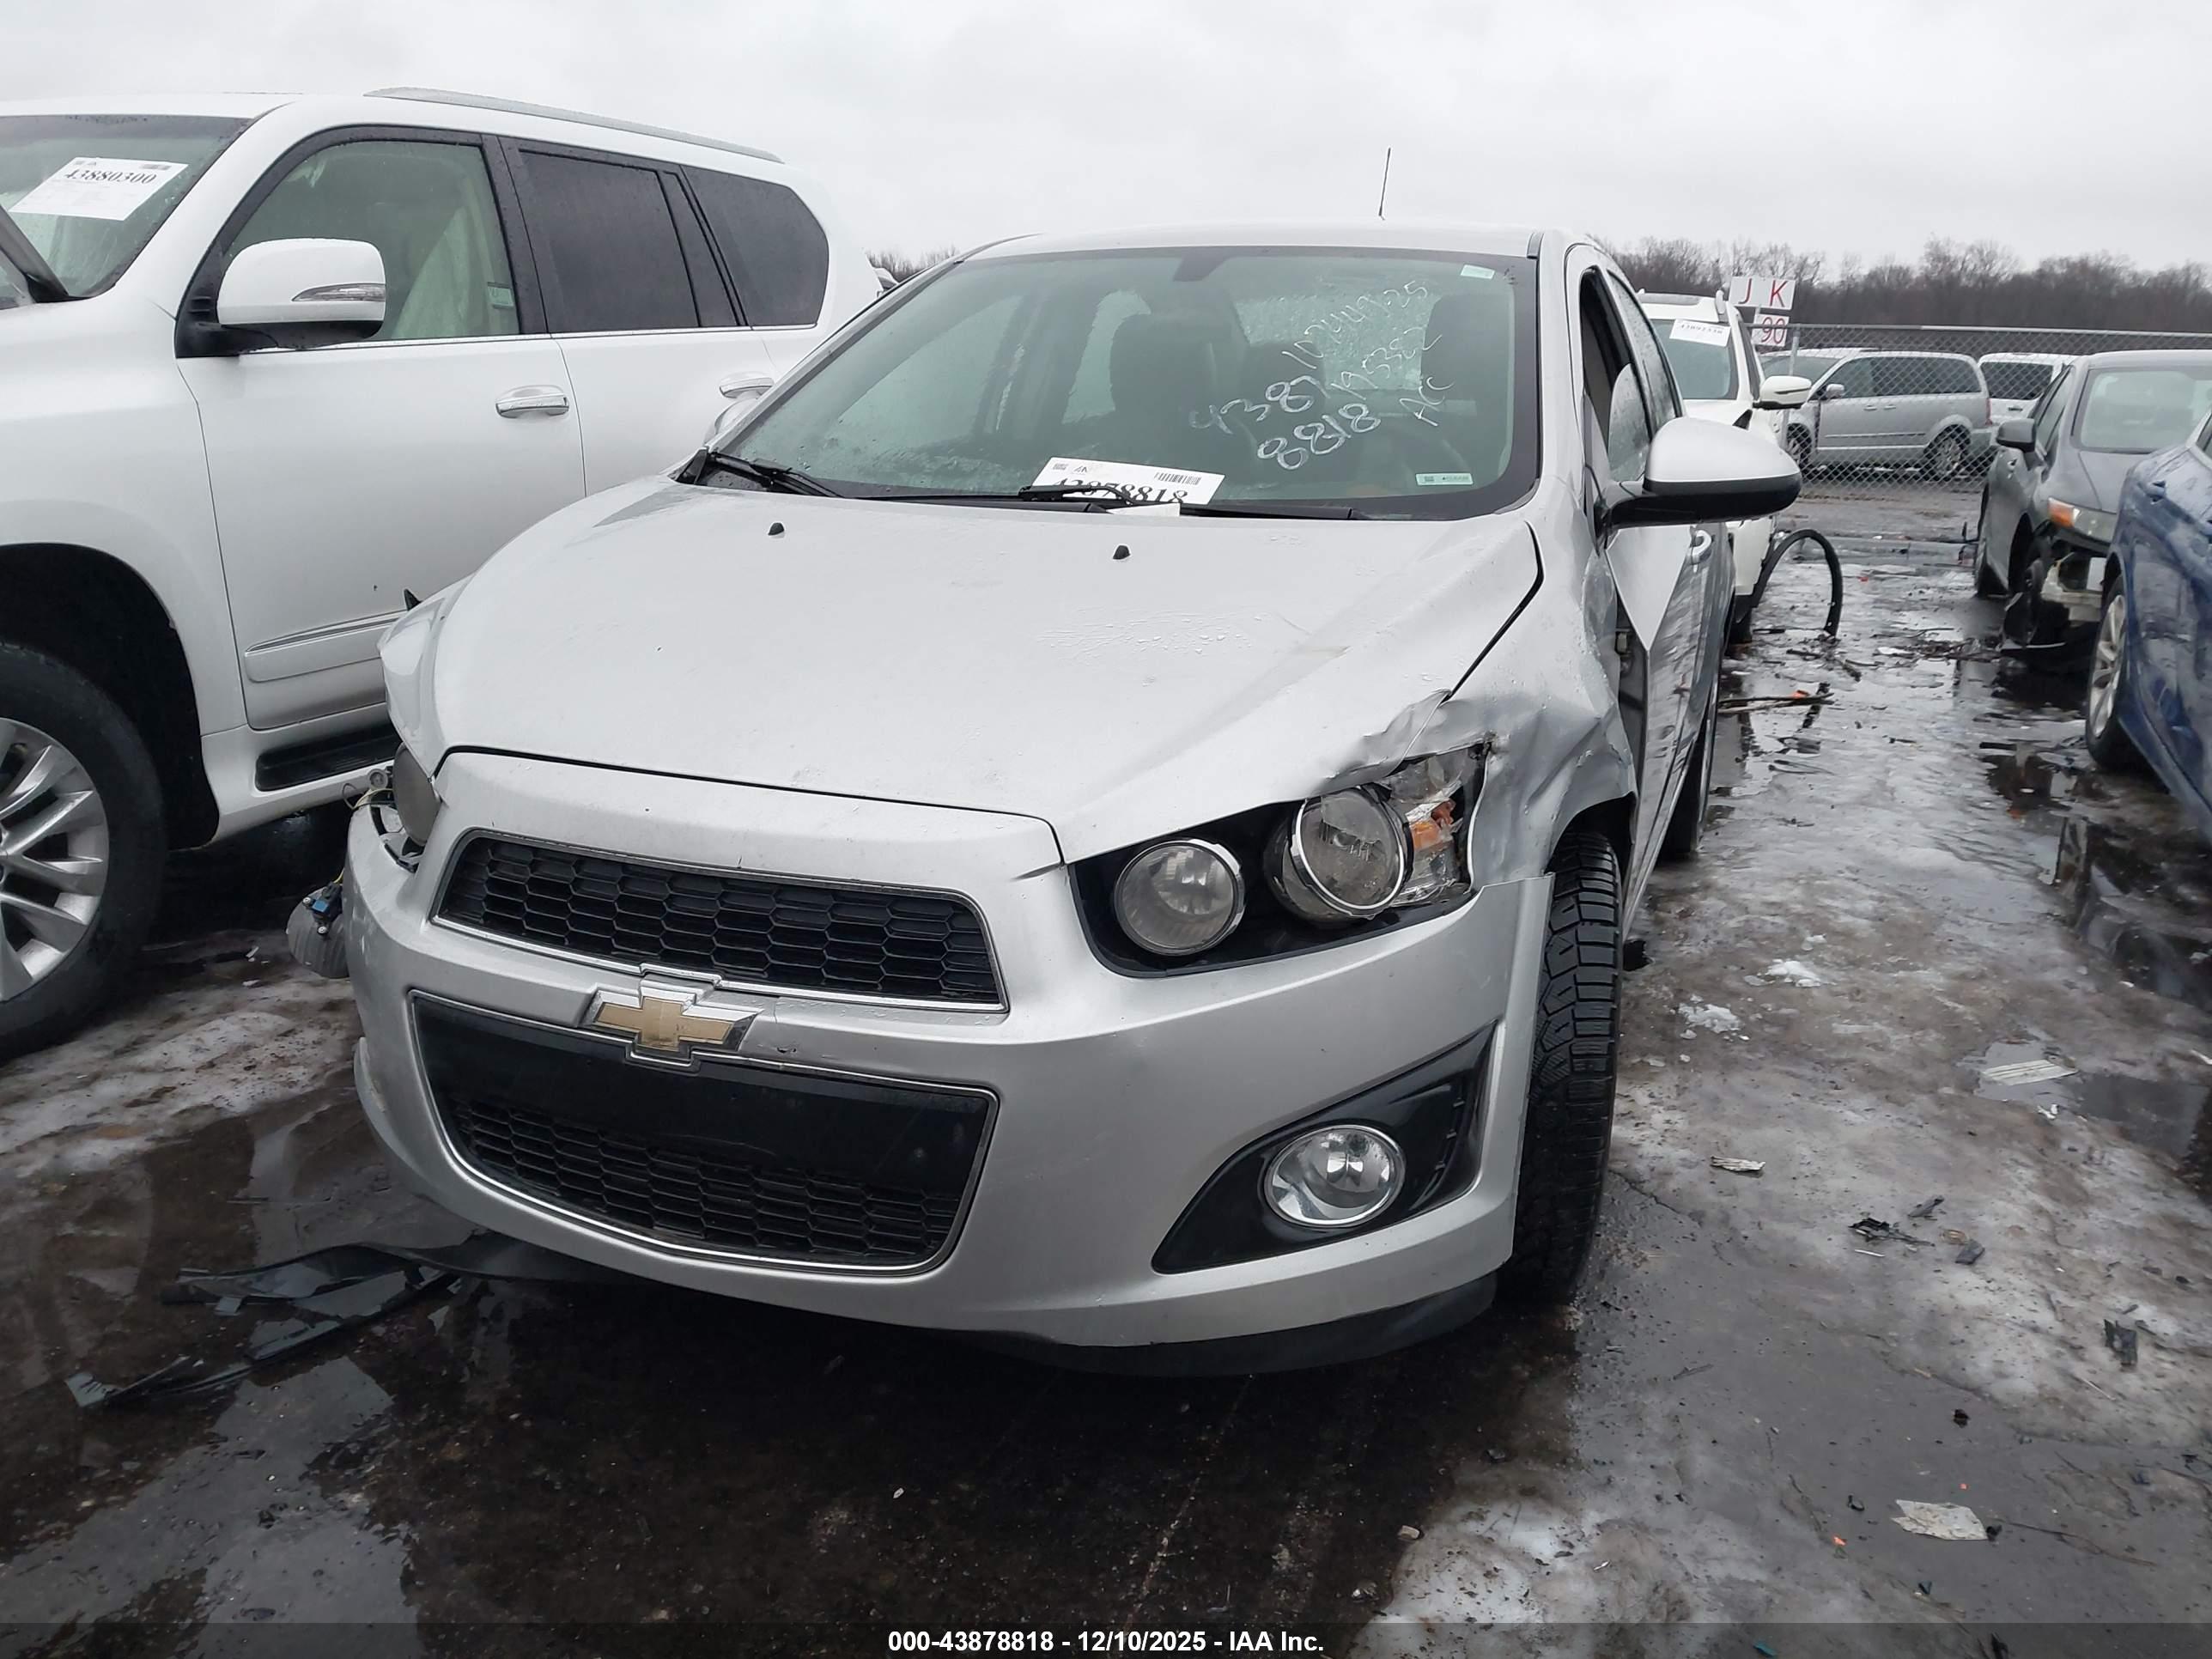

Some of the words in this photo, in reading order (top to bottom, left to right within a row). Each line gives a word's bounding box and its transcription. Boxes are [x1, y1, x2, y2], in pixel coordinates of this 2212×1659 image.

[65, 169, 157, 184] 43880300
[1738, 278, 1753, 305] J
[1770, 280, 1789, 307] K
[1761, 317, 1785, 344] 90
[1257, 404, 1382, 471] 8818
